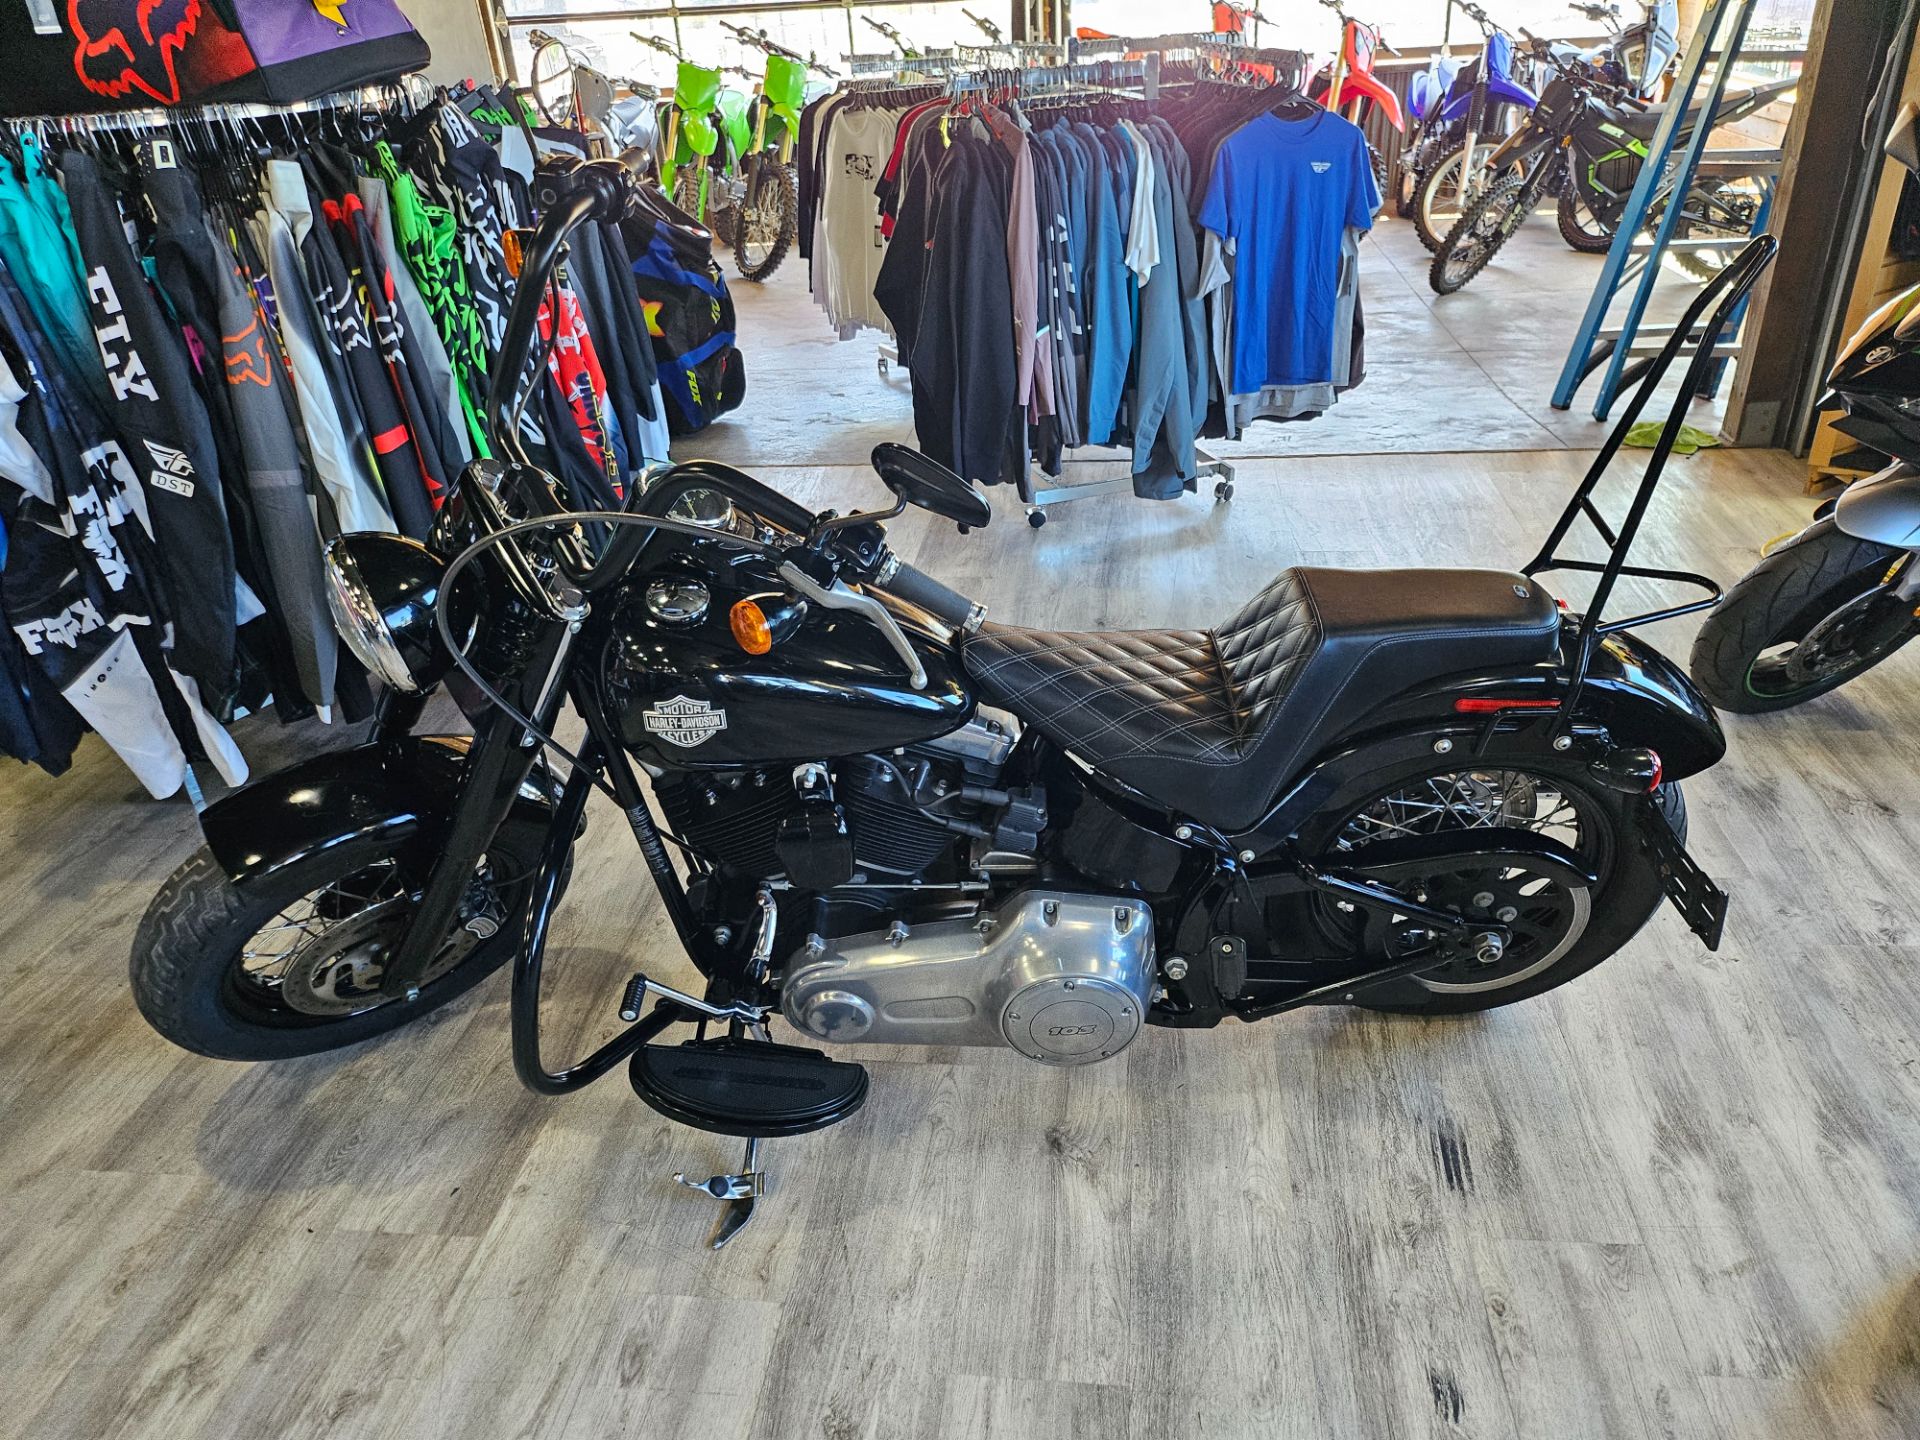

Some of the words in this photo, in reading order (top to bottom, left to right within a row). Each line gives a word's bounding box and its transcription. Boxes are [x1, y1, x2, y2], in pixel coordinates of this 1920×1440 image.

[87, 265, 160, 402] FLY
[686, 369, 703, 407] FOX
[156, 474, 191, 494] DST
[662, 704, 702, 715] MOTOR
[648, 714, 721, 729] HARLEY-DAVIDSON
[667, 730, 706, 744] CYCLES
[1048, 1024, 1098, 1037] 103
